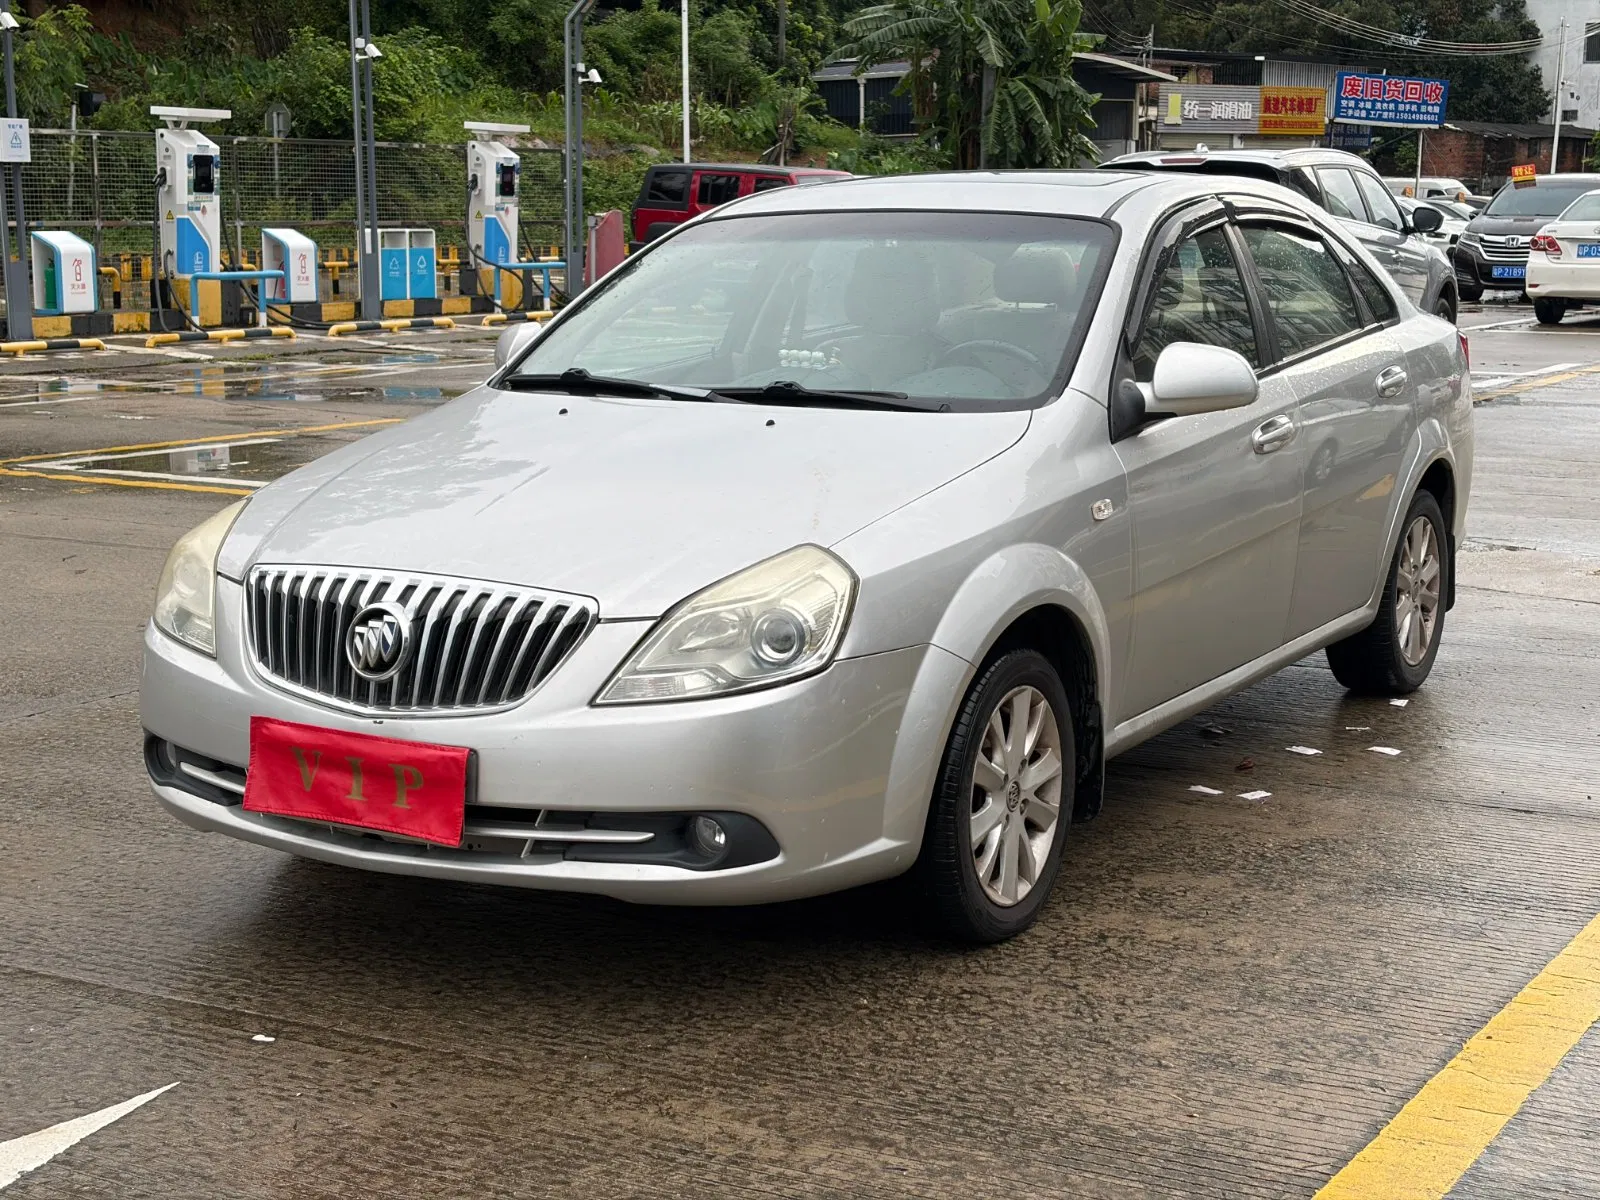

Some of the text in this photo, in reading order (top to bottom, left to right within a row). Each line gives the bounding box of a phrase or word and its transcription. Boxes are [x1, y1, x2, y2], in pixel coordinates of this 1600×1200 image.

[1341, 75, 1444, 104] 废旧货回收
[1183, 100, 1252, 120] 统一润滑油
[1340, 99, 1355, 108] 空调
[1358, 101, 1372, 109] 冰箱
[1375, 102, 1395, 111] 洗衣机
[1340, 109, 1367, 118] 二手设备
[291, 747, 424, 809] VIP
